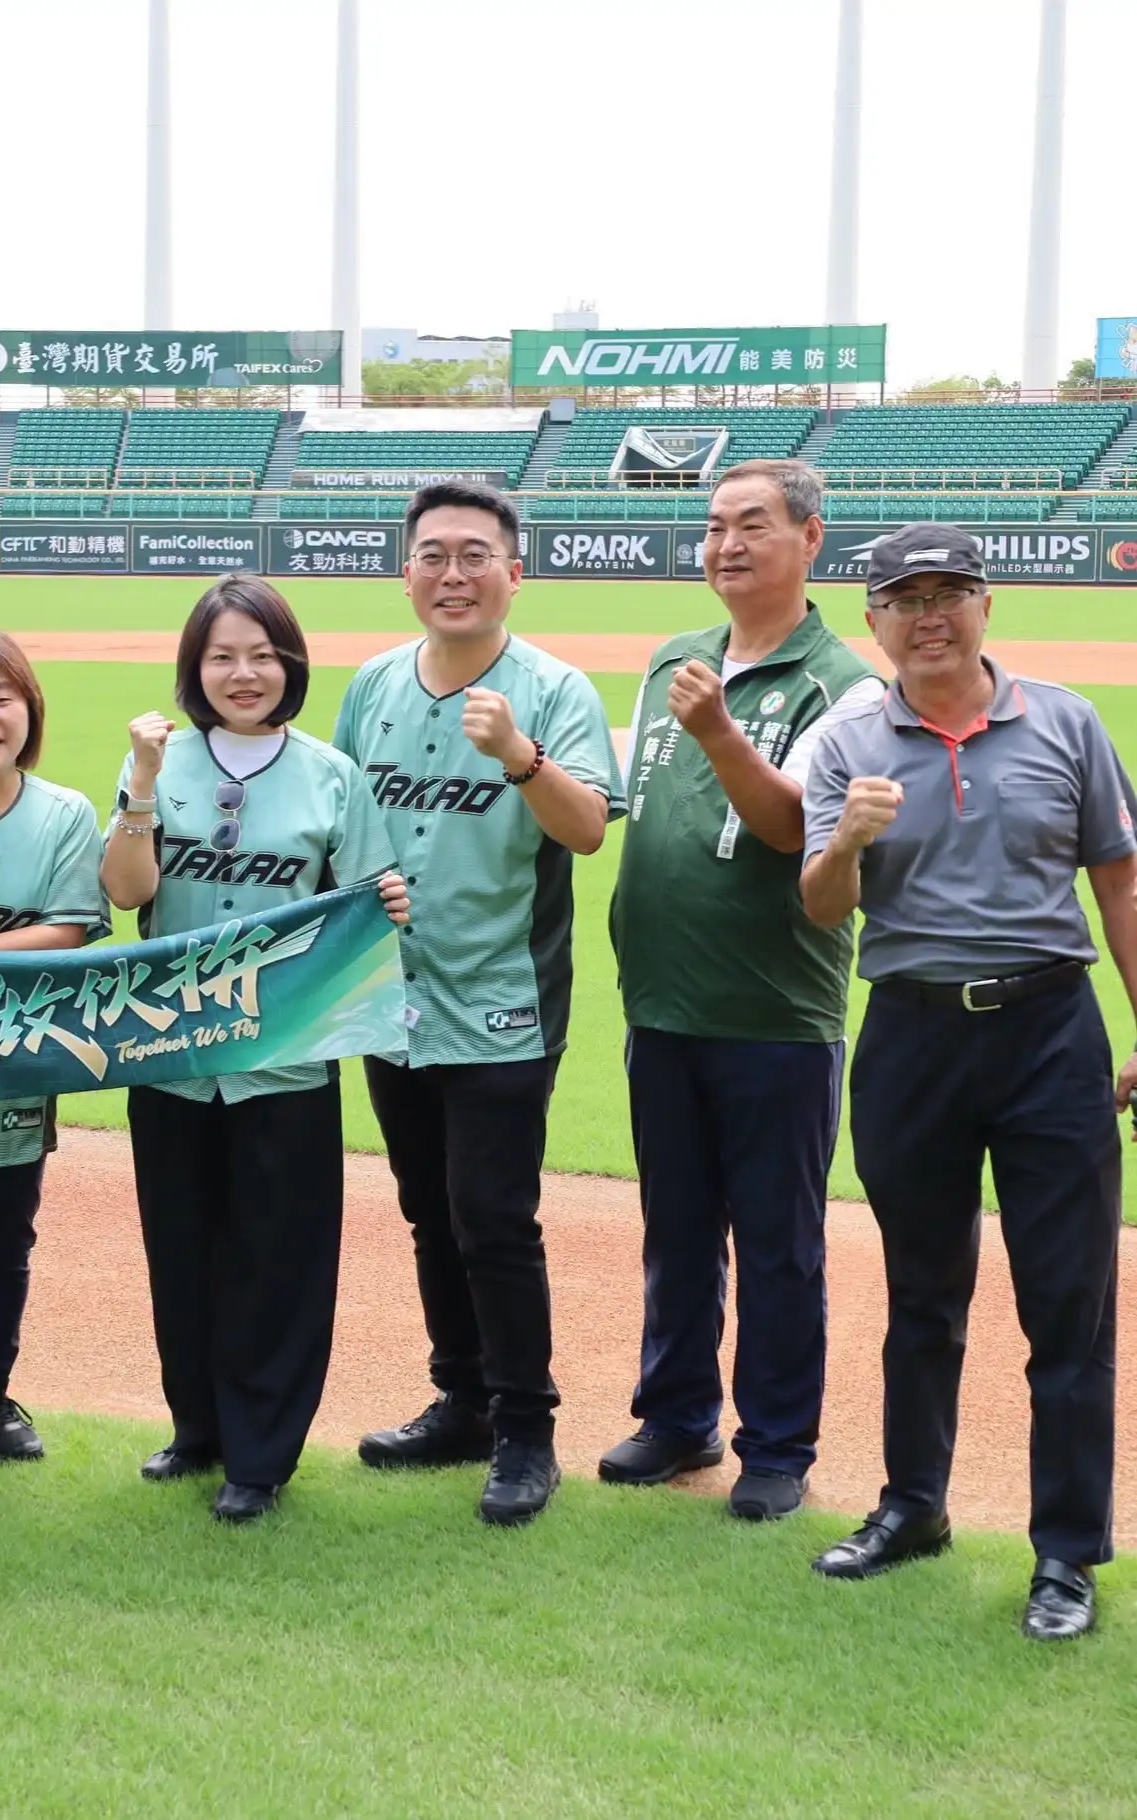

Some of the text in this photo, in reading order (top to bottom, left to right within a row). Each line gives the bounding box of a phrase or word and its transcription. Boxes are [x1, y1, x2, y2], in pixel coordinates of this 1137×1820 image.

[13, 342, 218, 375] 臺灣期貨交易所
[537, 337, 740, 376] NOHMI
[739, 348, 858, 371] 能美防災
[234, 362, 313, 374] TAIFEX Cares
[313, 473, 365, 486] HOME
[371, 474, 409, 486] RUN
[49, 535, 125, 554] 和勤精機
[139, 534, 254, 550] FamiCollection
[305, 530, 386, 547] CAMEO
[550, 534, 656, 567] SPARK
[288, 552, 384, 572] 友勁科技
[577, 561, 635, 570] PROTEIN
[827, 563, 864, 574] FIEL
[983, 563, 1075, 574] iniLED大型顯示器
[363, 761, 510, 817] TAKAO
[161, 835, 311, 889] TAKAO
[114, 1017, 261, 1064] Together We Fly
